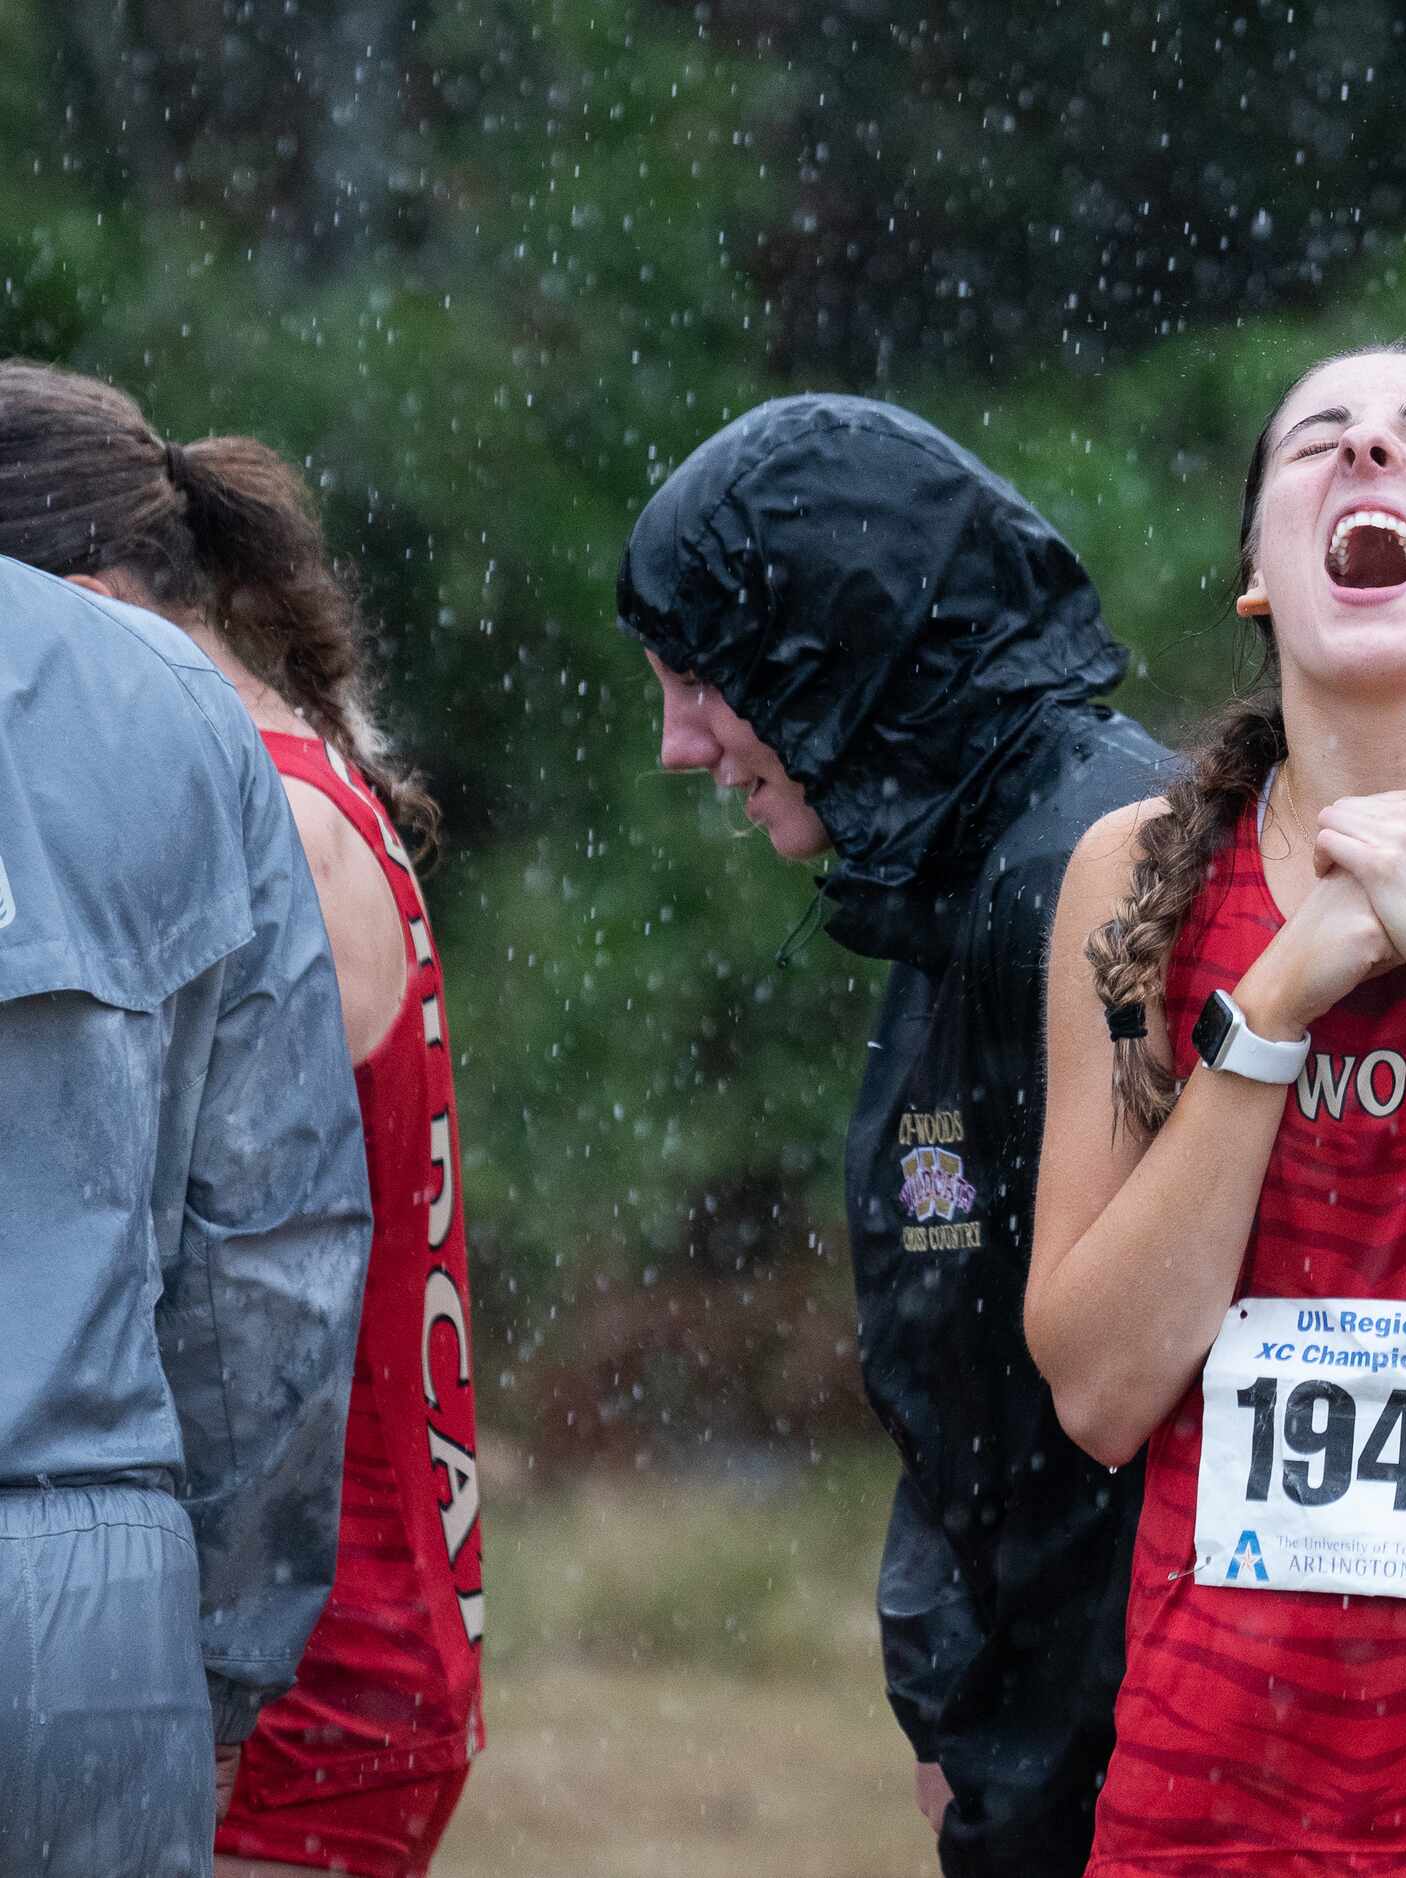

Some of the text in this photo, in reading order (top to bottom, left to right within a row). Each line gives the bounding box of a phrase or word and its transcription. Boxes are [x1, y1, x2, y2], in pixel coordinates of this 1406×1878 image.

[1297, 1310, 1335, 1333] UIL
[1254, 1342, 1295, 1361] XC
[1277, 1535, 1299, 1550] The
[1304, 1536, 1367, 1554] University
[1373, 1540, 1388, 1555] of
